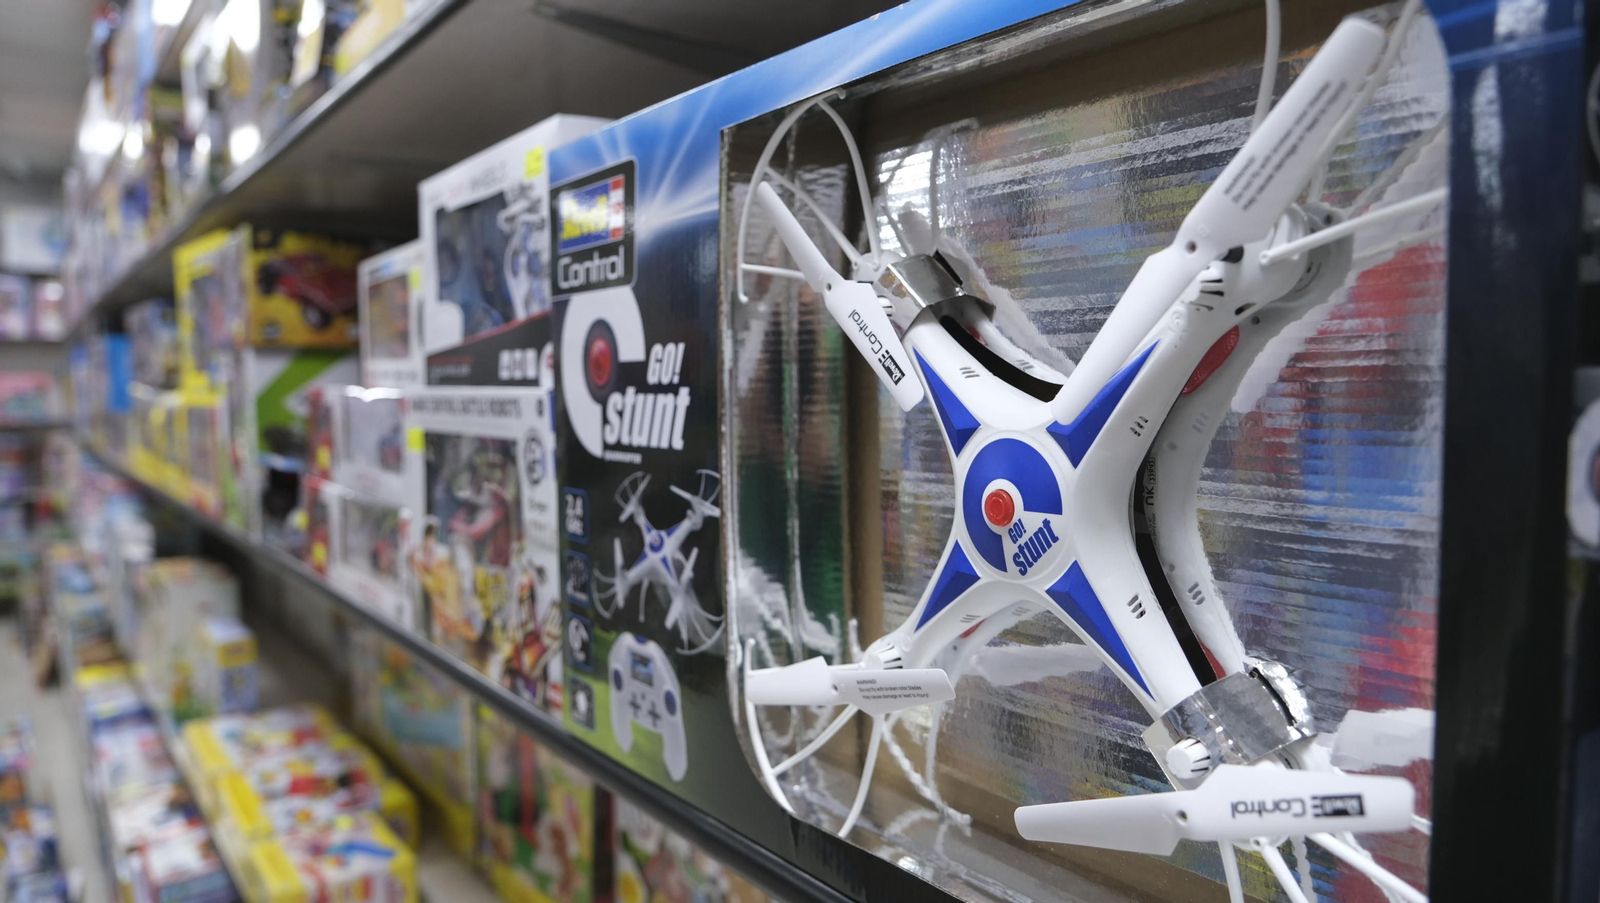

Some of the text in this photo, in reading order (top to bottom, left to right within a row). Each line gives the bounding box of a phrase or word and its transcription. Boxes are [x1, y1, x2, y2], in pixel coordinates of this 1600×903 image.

[557, 245, 624, 289] Control
[646, 343, 685, 385] GO!
[848, 309, 903, 381] Revell Control
[603, 386, 691, 450] stunt
[1008, 518, 1027, 545] GO!
[1012, 518, 1060, 577] stunt
[1231, 798, 1306, 818] Control
